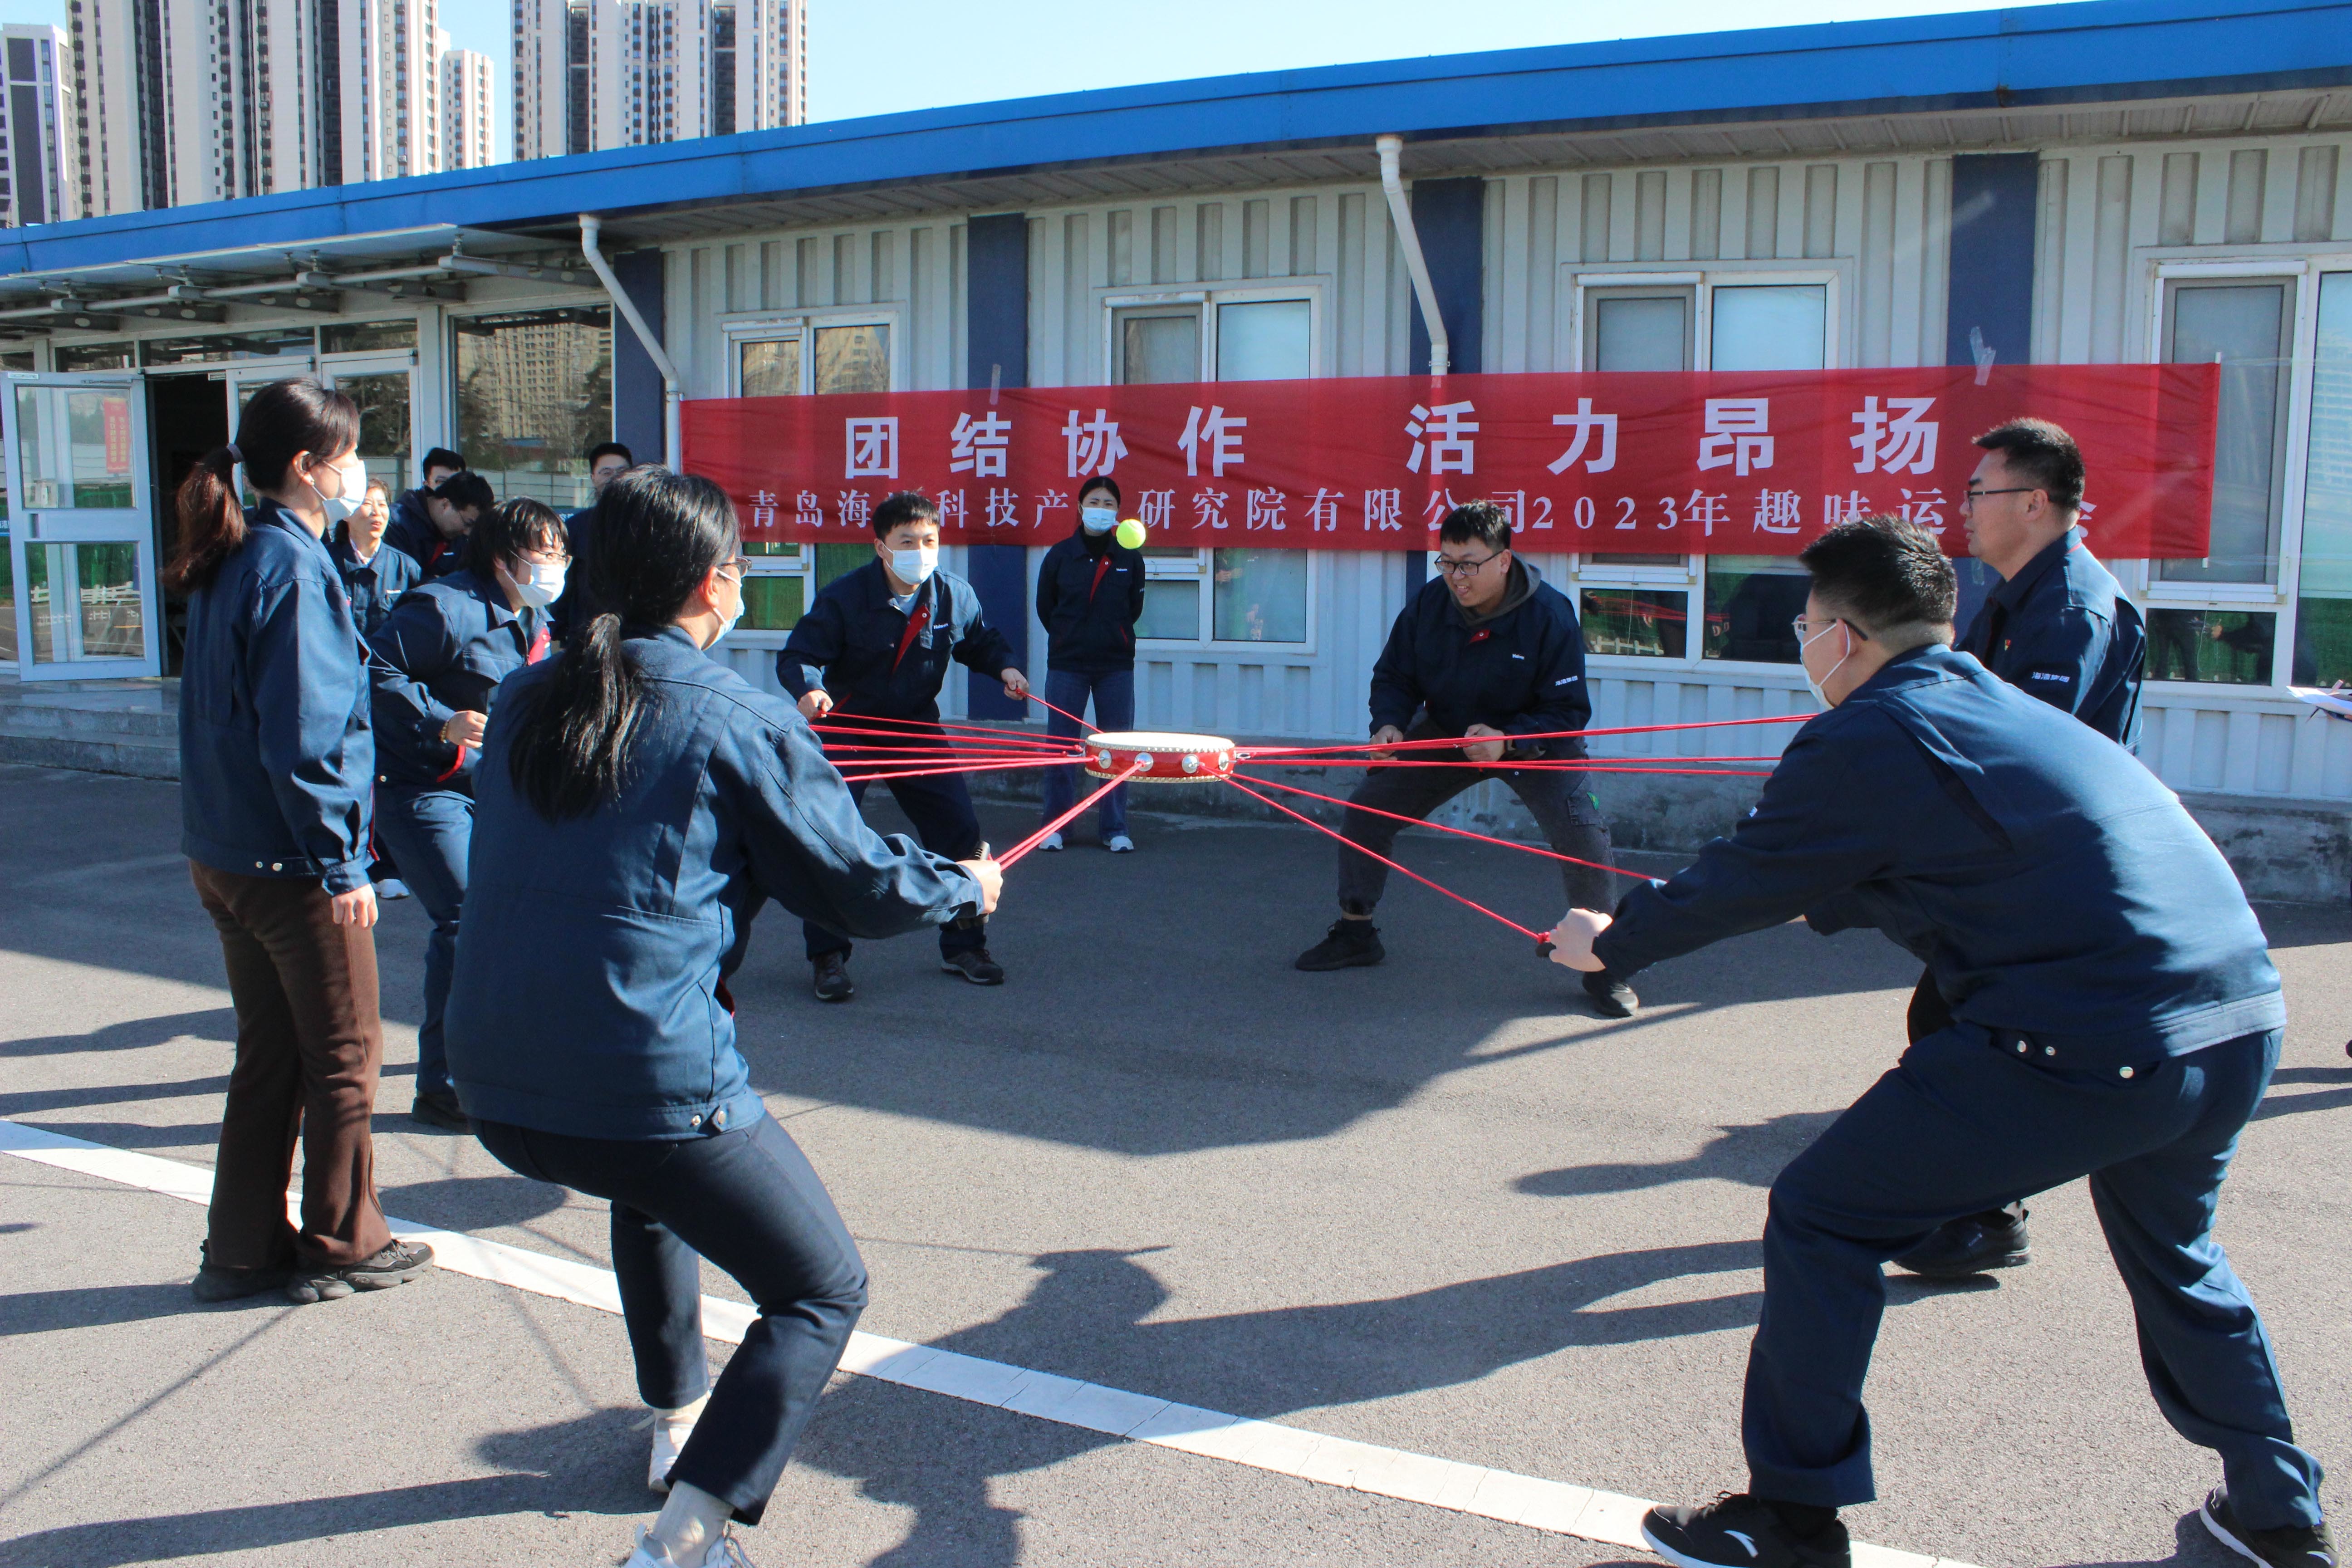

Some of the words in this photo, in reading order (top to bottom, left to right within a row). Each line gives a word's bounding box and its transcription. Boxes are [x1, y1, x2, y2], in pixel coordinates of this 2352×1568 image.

[844, 405, 1247, 479] 团结协作
[1404, 396, 1940, 477] 活力昂扬
